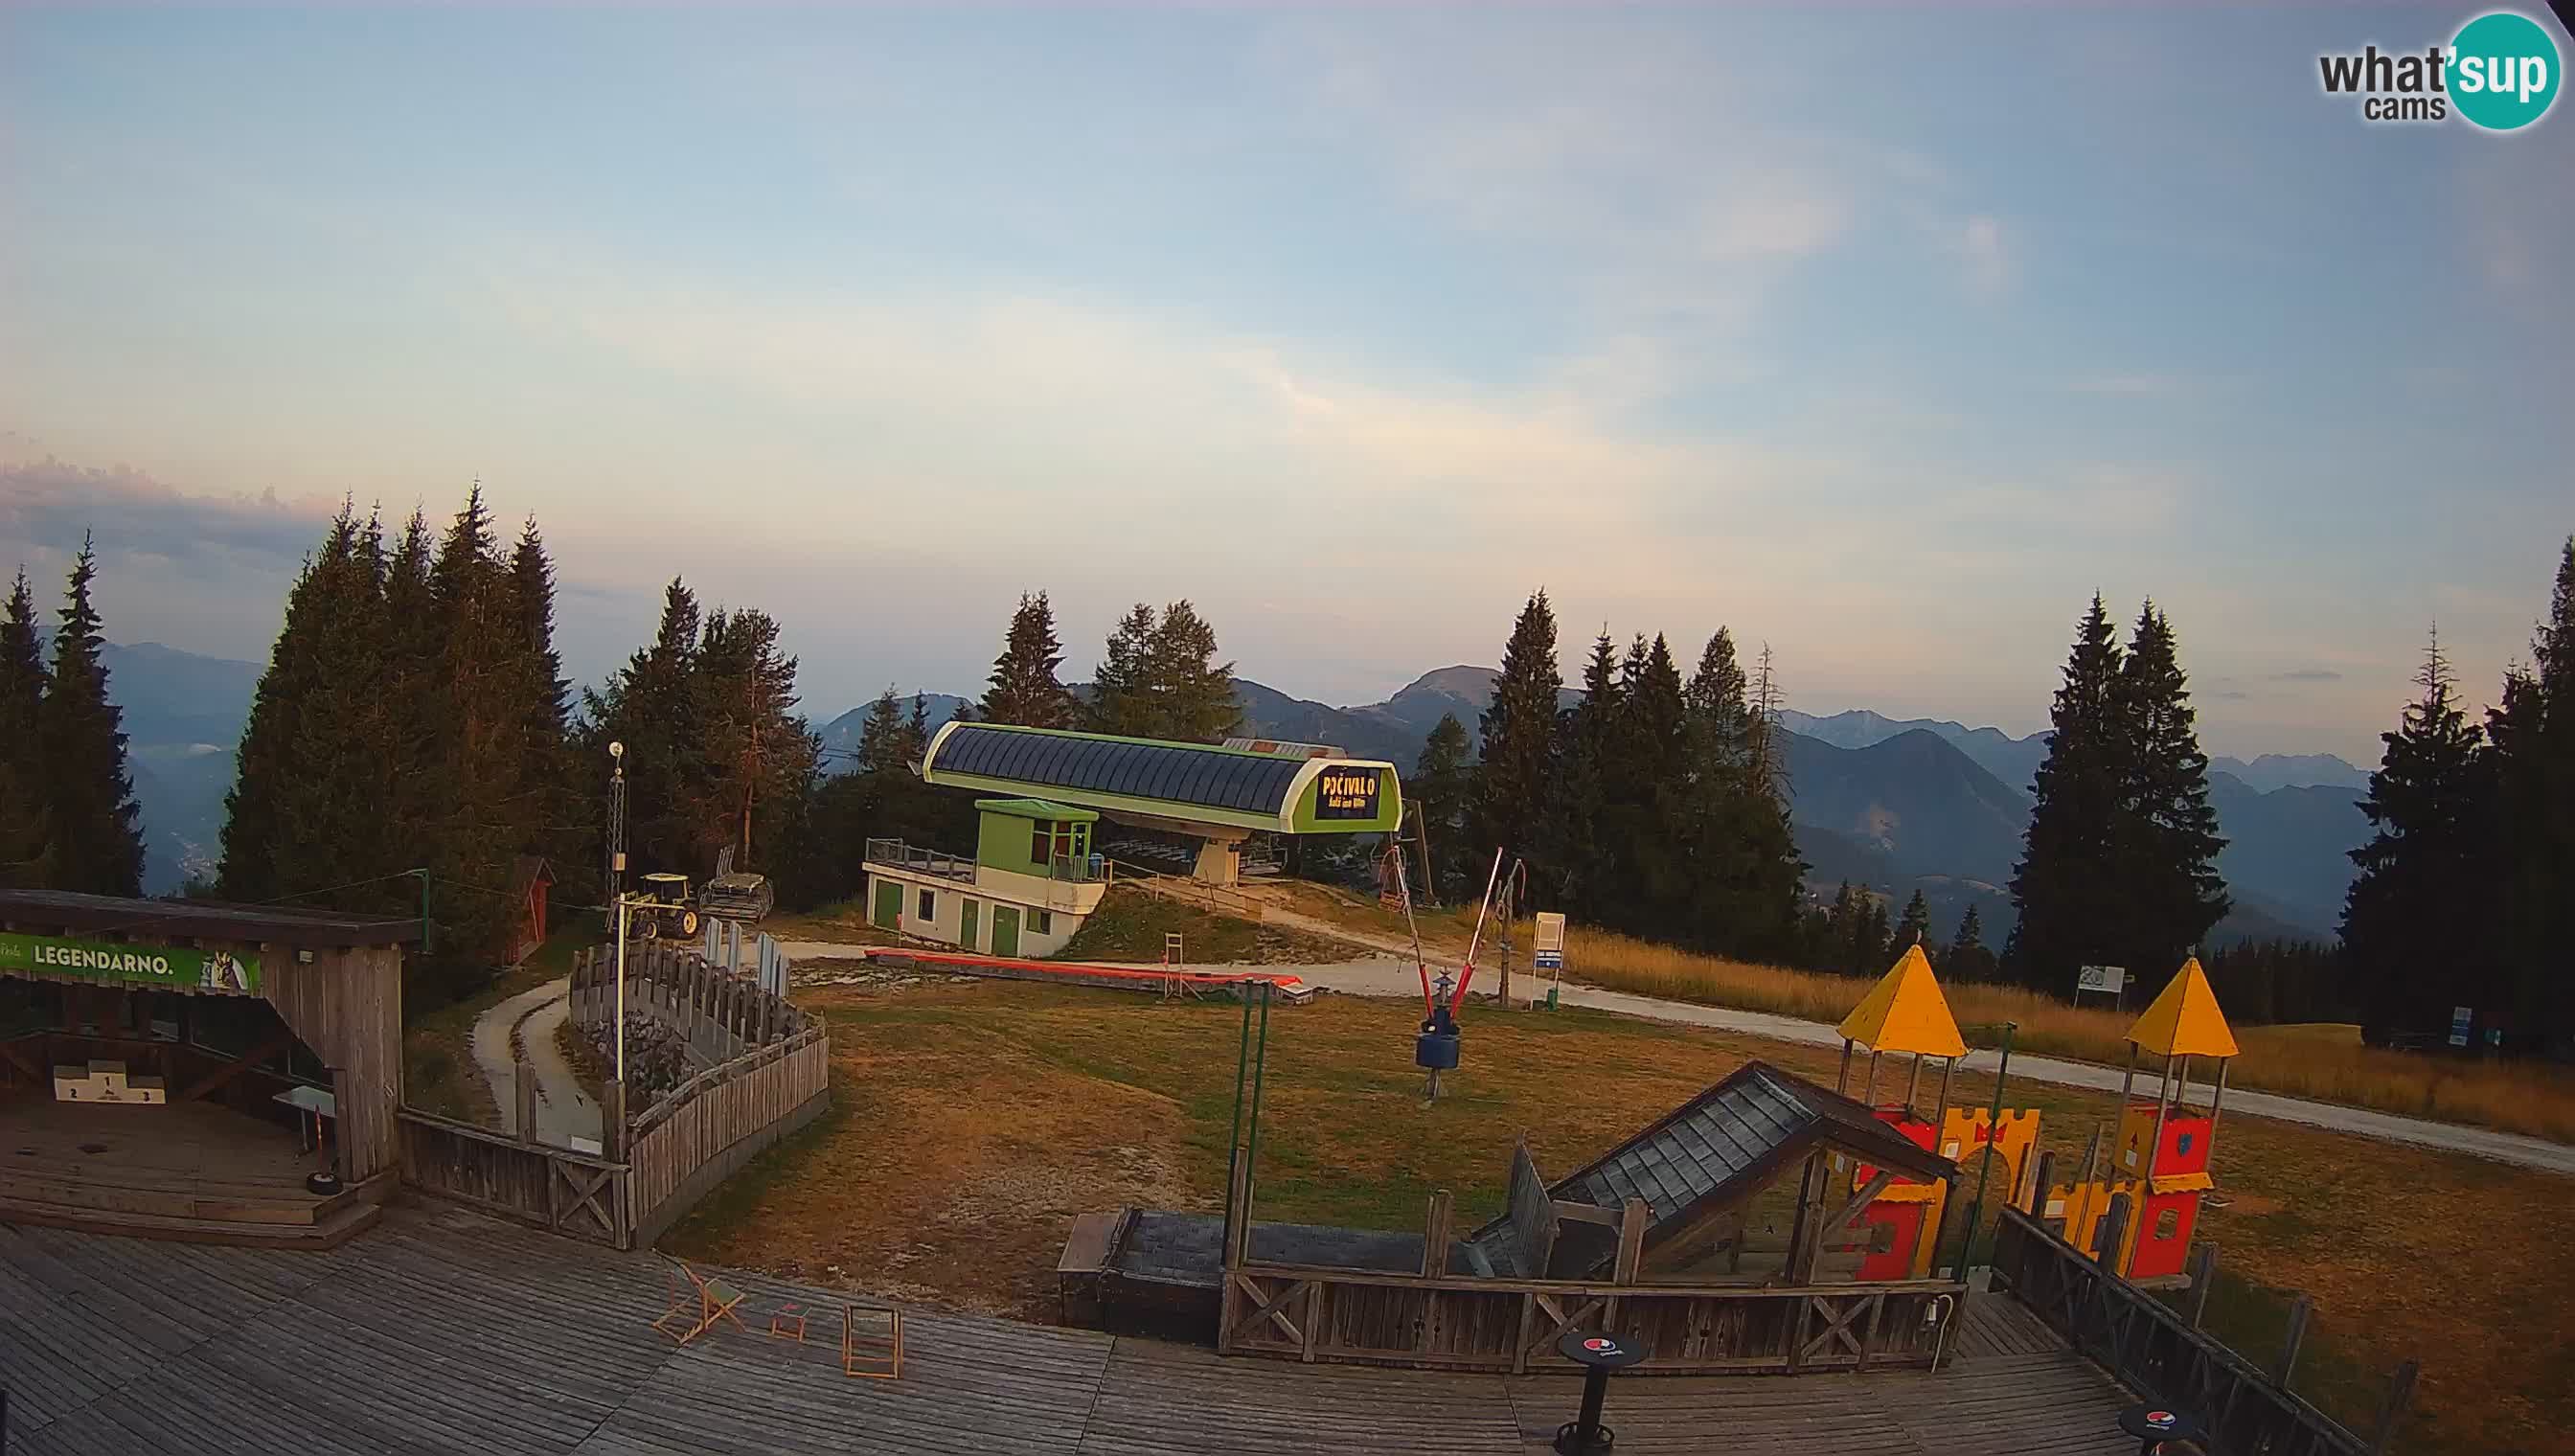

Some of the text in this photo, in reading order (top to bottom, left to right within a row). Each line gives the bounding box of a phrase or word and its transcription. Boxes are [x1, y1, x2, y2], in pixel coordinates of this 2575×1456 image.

[34, 944, 174, 975] LEGENDARNO.
[70, 1088, 78, 1099] 2
[143, 1091, 150, 1103] 3
